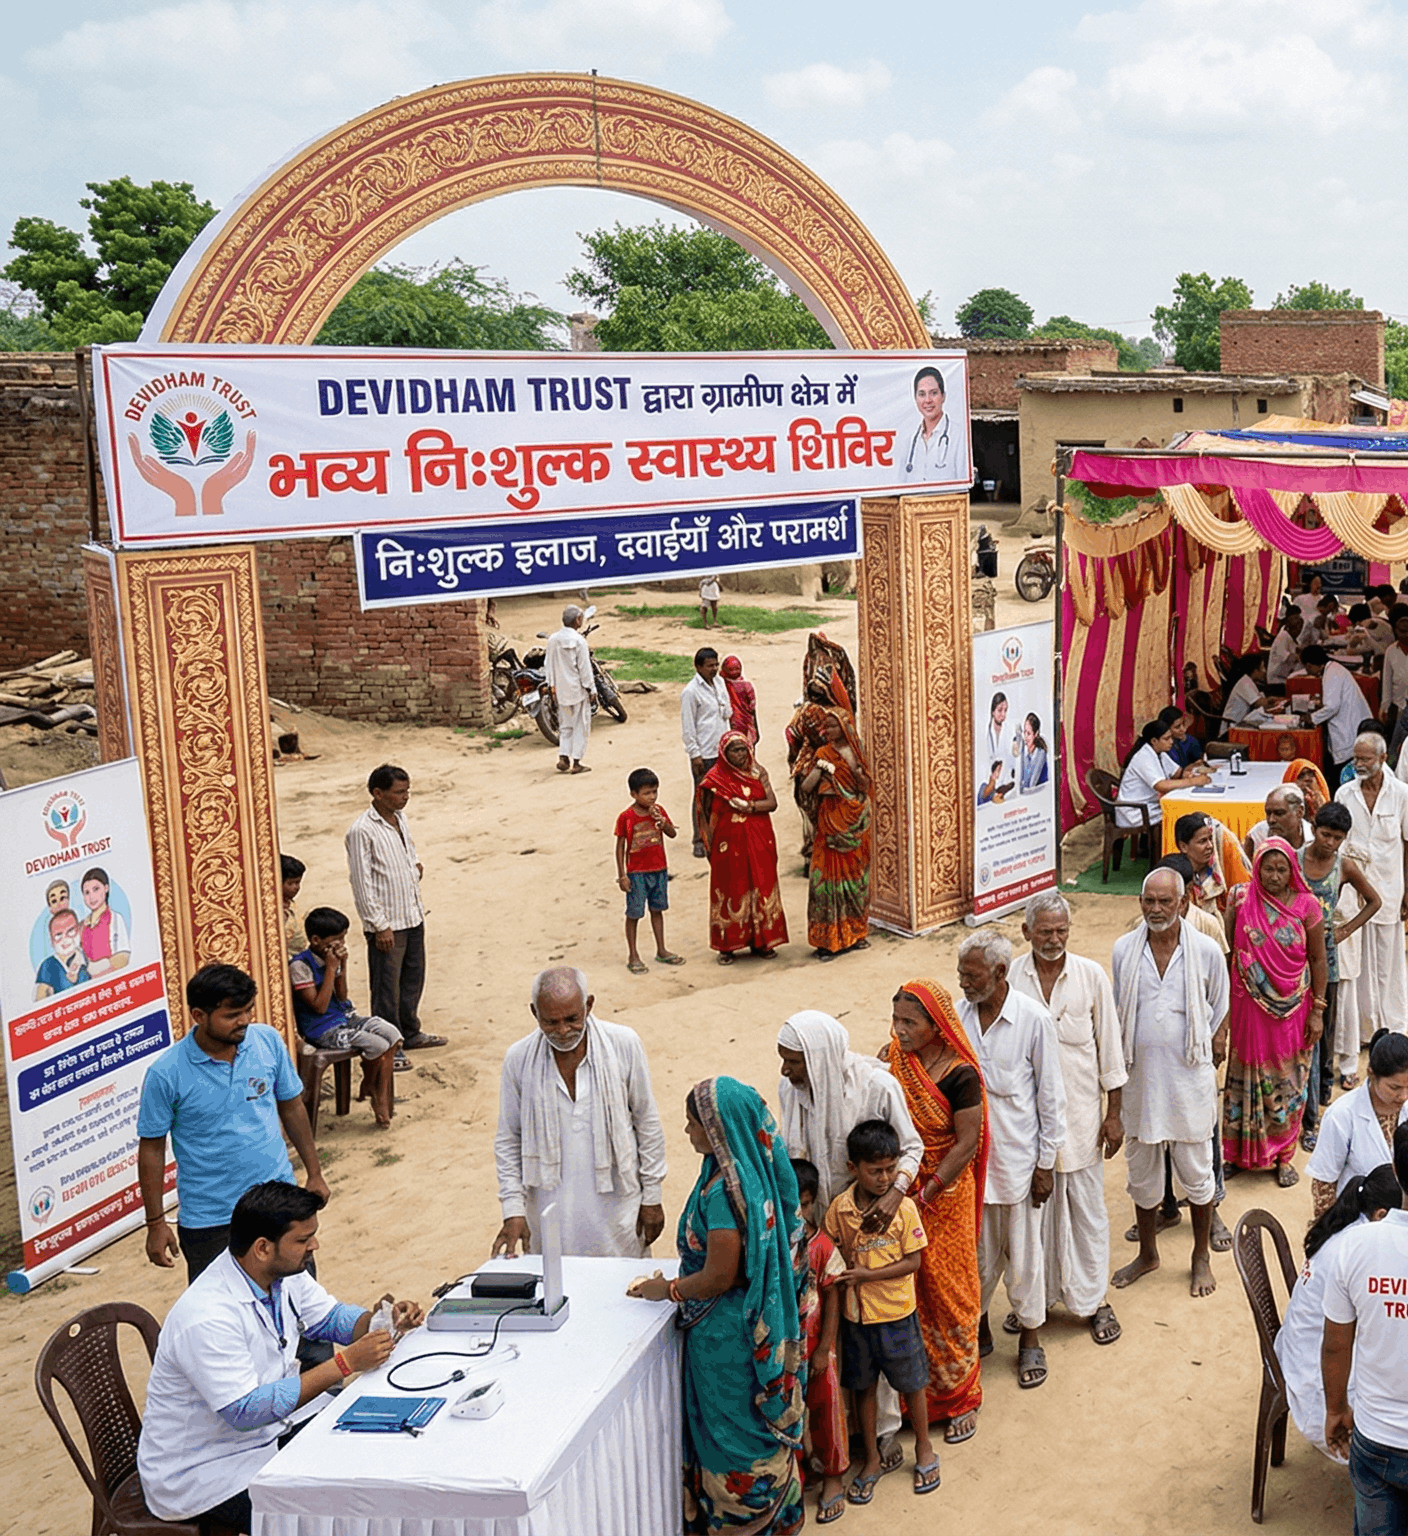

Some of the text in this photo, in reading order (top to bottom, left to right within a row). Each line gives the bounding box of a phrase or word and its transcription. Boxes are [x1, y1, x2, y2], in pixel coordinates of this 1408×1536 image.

[124, 371, 257, 422] DEVIDHAM TRUST
[317, 373, 858, 416] DEVIDHAM TRUST द्वारा ग्रामीण क्षेत्र में
[268, 417, 897, 511] भव्य निःशुल्क स्वास्थ्य शिविर
[375, 505, 849, 589] निःशुल्क इलाज, दवाईयाँ और परामर्श
